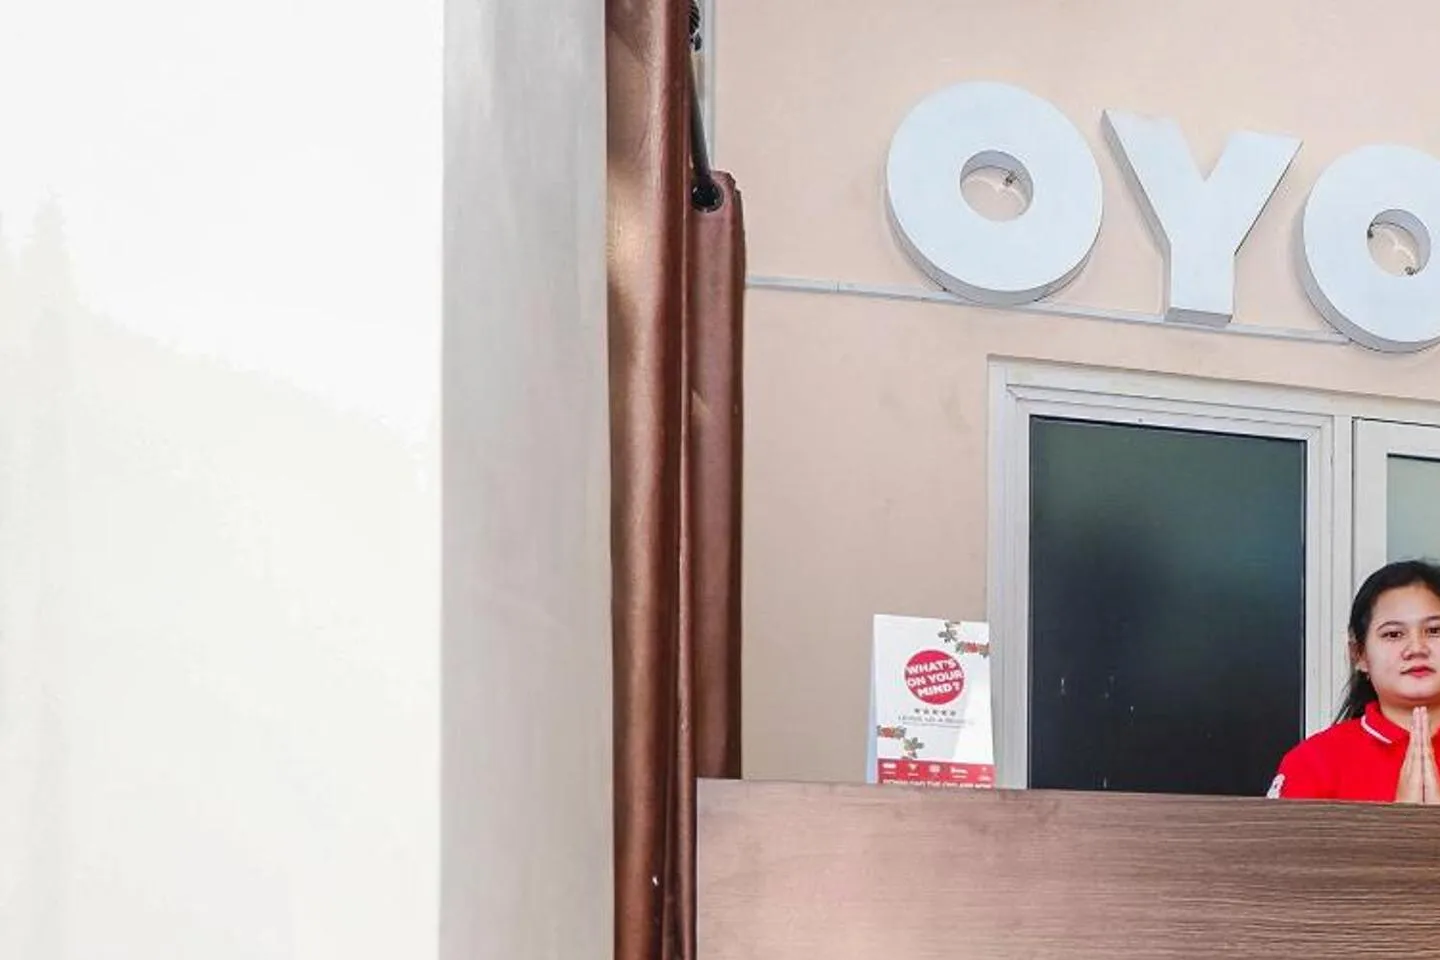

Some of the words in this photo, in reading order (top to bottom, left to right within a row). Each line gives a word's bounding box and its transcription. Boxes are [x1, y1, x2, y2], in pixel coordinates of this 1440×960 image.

[907, 659, 956, 675] WHAT'S
[908, 675, 927, 687] ON
[928, 670, 963, 684] YOUR
